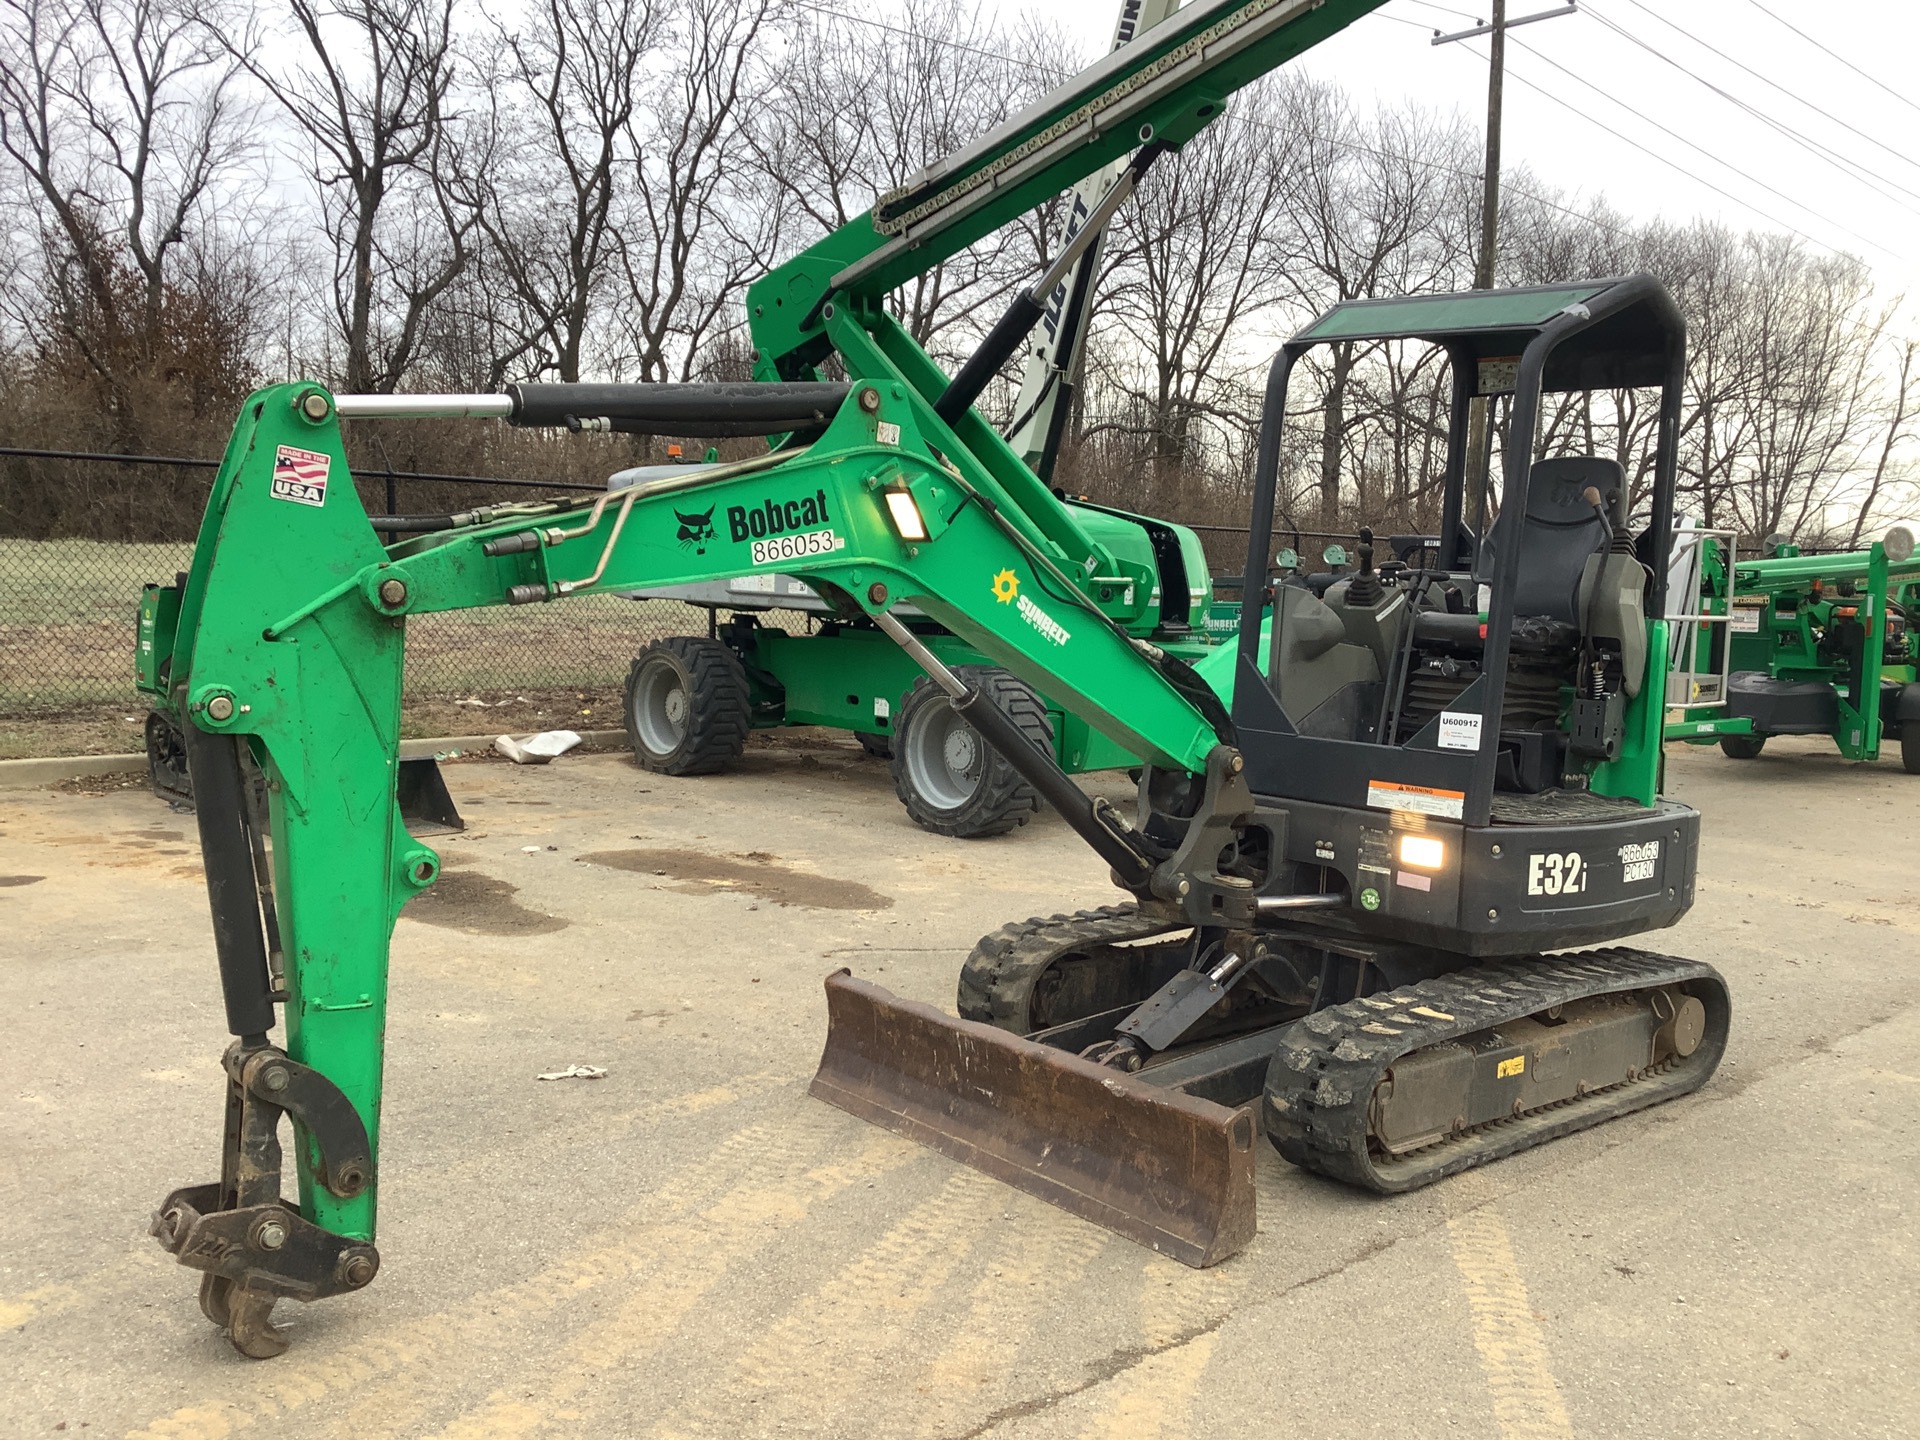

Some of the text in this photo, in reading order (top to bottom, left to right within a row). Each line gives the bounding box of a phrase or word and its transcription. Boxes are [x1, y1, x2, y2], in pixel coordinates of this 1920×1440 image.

[1043, 282, 1068, 345] JLG
[280, 448, 302, 458] MADE
[275, 480, 320, 501] USA
[727, 489, 829, 543] Bobcat
[753, 531, 833, 563] 866053
[1016, 594, 1071, 647] SUNBELT
[1442, 718, 1479, 728] U600912
[1405, 785, 1434, 795] WARNING
[1623, 841, 1658, 862] 866053
[1528, 852, 1587, 896] E32i
[1624, 861, 1654, 881] PC130
[1366, 894, 1376, 904] T4
